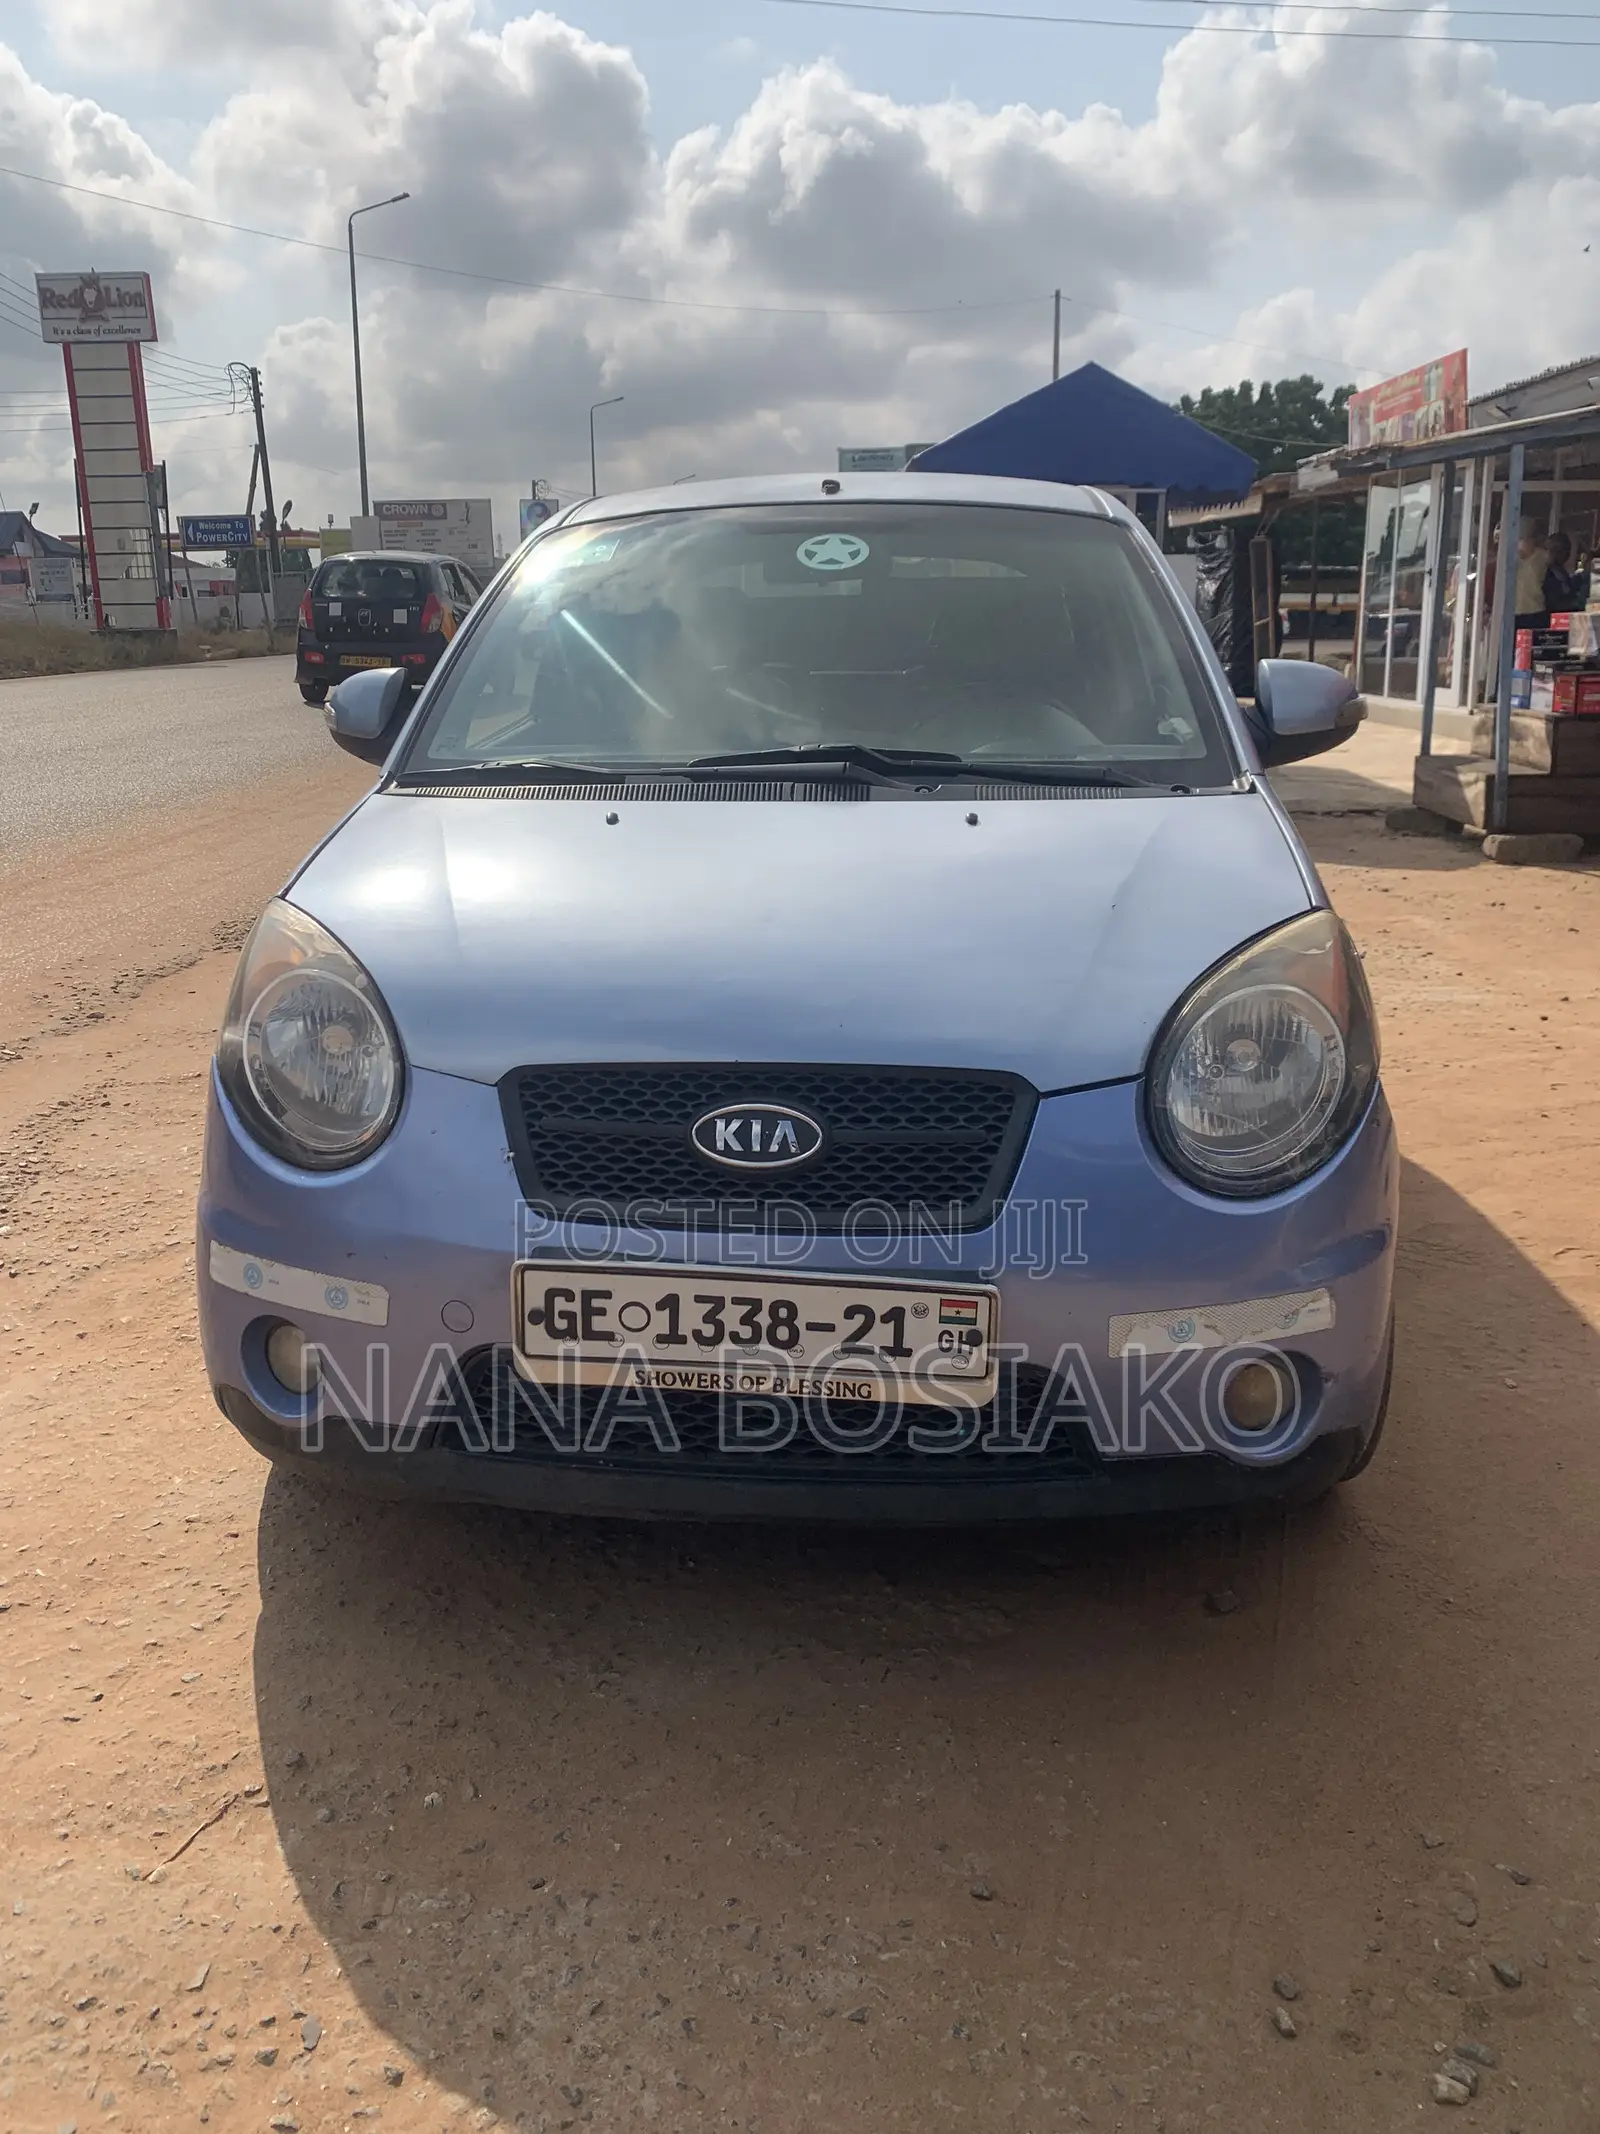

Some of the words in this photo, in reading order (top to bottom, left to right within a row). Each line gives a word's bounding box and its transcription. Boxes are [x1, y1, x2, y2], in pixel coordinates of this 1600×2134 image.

[39, 287, 81, 309] Red
[104, 285, 145, 307] Lion
[73, 326, 92, 335] class
[94, 325, 102, 336] of
[103, 325, 141, 334] excellence
[382, 504, 428, 516] CROWN
[199, 521, 231, 530] Welcome
[235, 521, 244, 529] To
[714, 1118, 799, 1153] KIA
[544, 1287, 615, 1342] GE
[655, 1293, 914, 1358] 1338-21
[937, 1330, 975, 1356] GH
[635, 1370, 734, 1391] SHOWERS
[739, 1375, 767, 1392] OF
[772, 1375, 872, 1400] BLESSING
